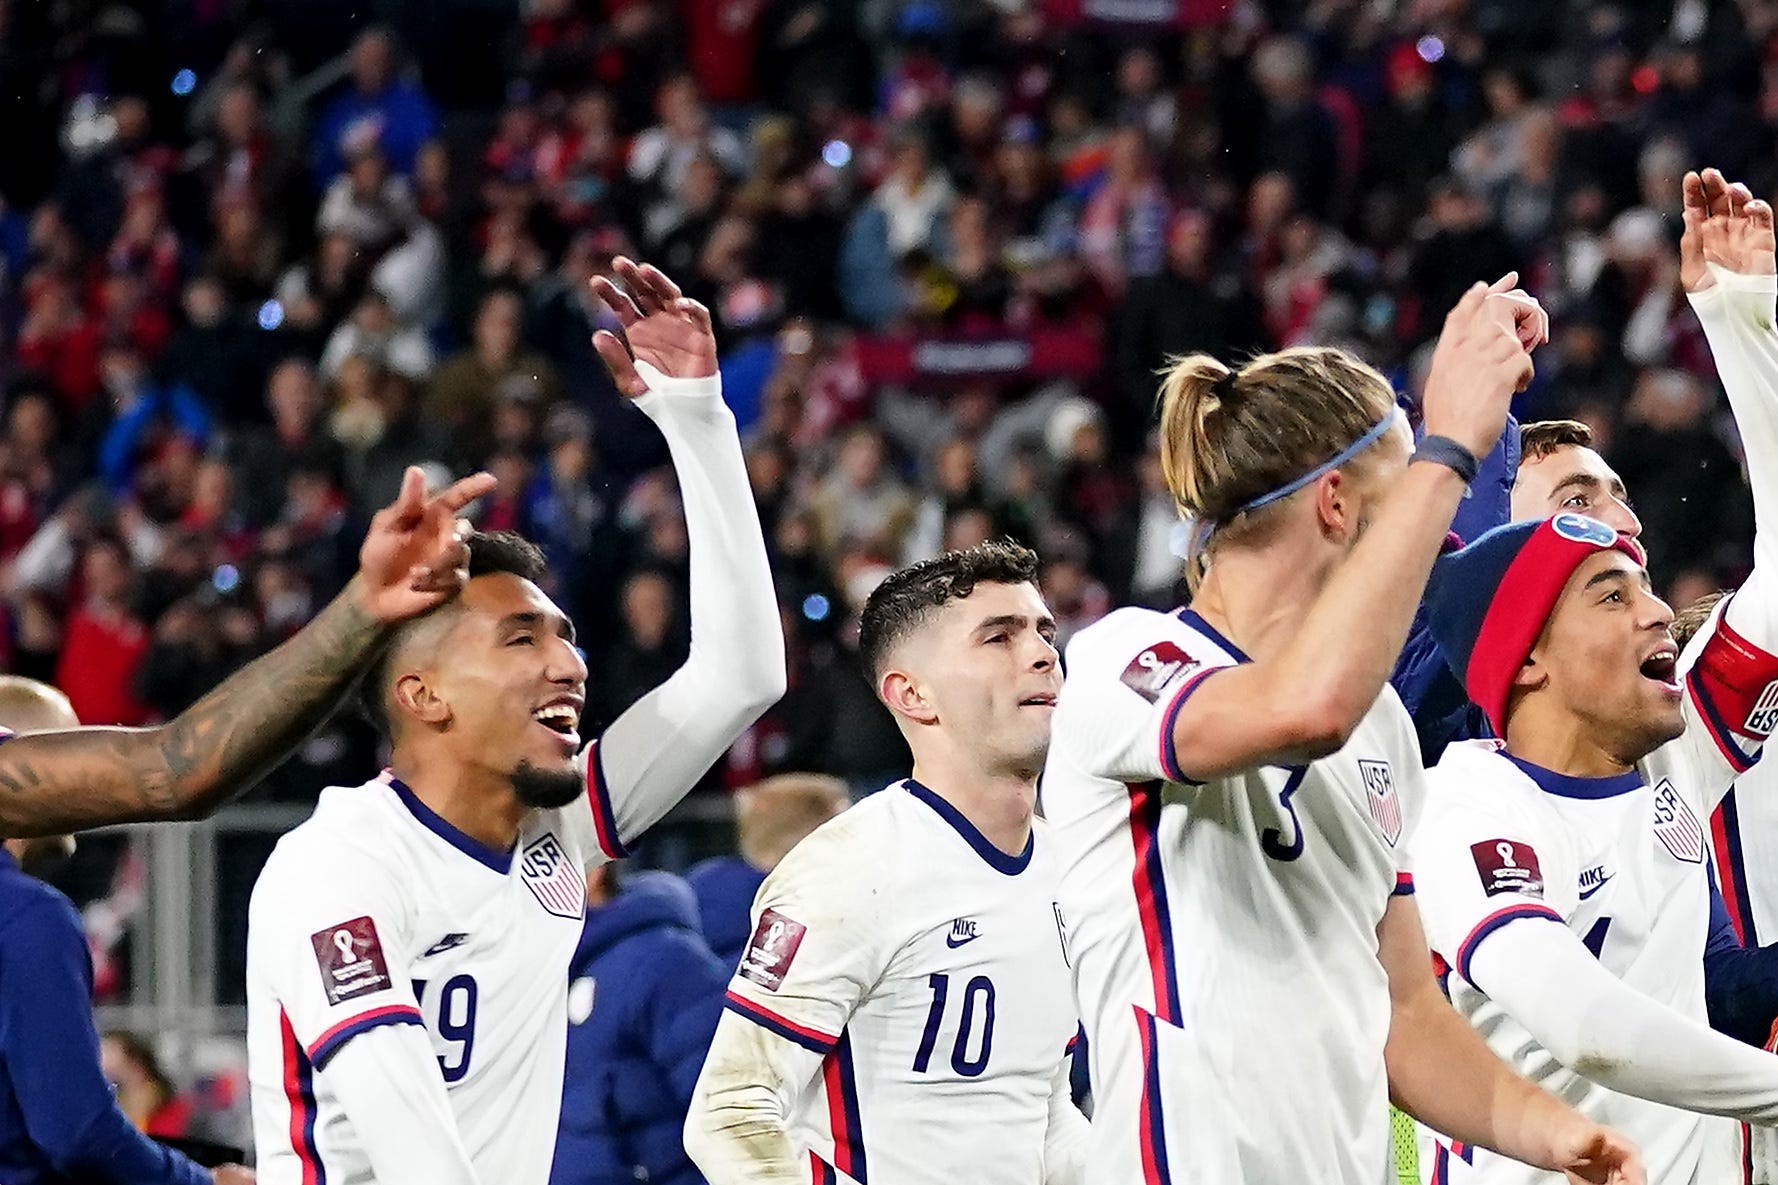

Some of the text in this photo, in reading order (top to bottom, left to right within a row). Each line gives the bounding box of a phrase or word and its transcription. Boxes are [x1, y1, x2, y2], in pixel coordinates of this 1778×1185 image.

[1363, 767, 1391, 796] USA
[521, 842, 561, 878] USA
[952, 918, 978, 936] NIKE
[912, 972, 996, 1078] 10
